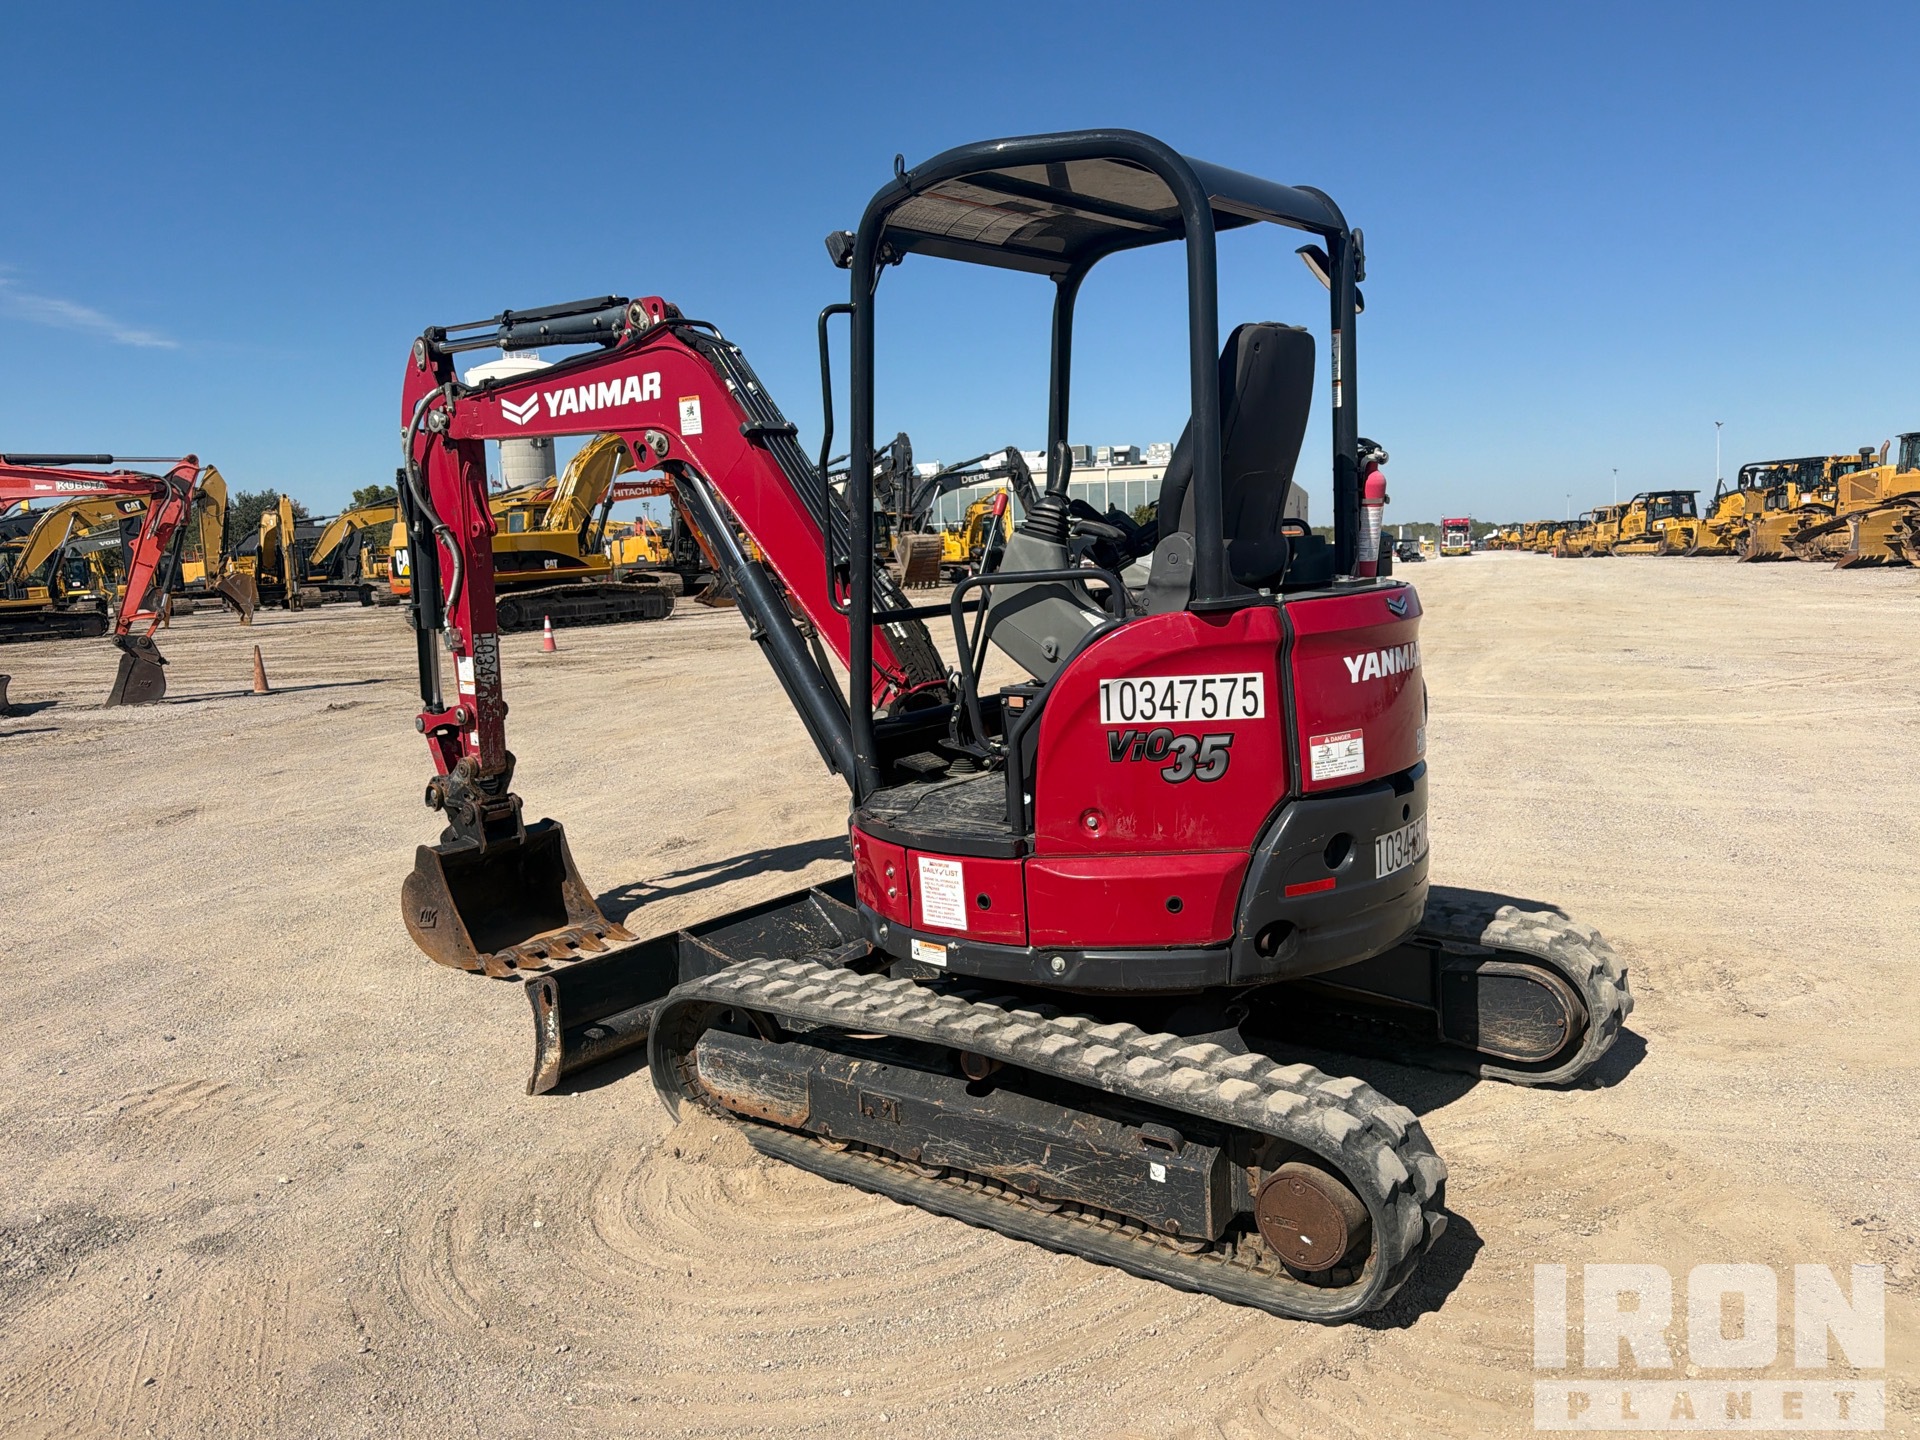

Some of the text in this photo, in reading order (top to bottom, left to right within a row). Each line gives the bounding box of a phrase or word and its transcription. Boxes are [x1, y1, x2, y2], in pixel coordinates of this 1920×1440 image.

[543, 371, 661, 417] YANMAR
[961, 472, 991, 484] DEERE
[56, 481, 107, 491] KUBOTA
[613, 487, 652, 497] HITACHI
[124, 501, 141, 512] CAT
[396, 549, 410, 576] CA
[544, 559, 558, 569] CAT
[1100, 676, 1259, 721] 10347575
[1330, 734, 1352, 743] DANGER
[922, 866, 939, 875] DAILY
